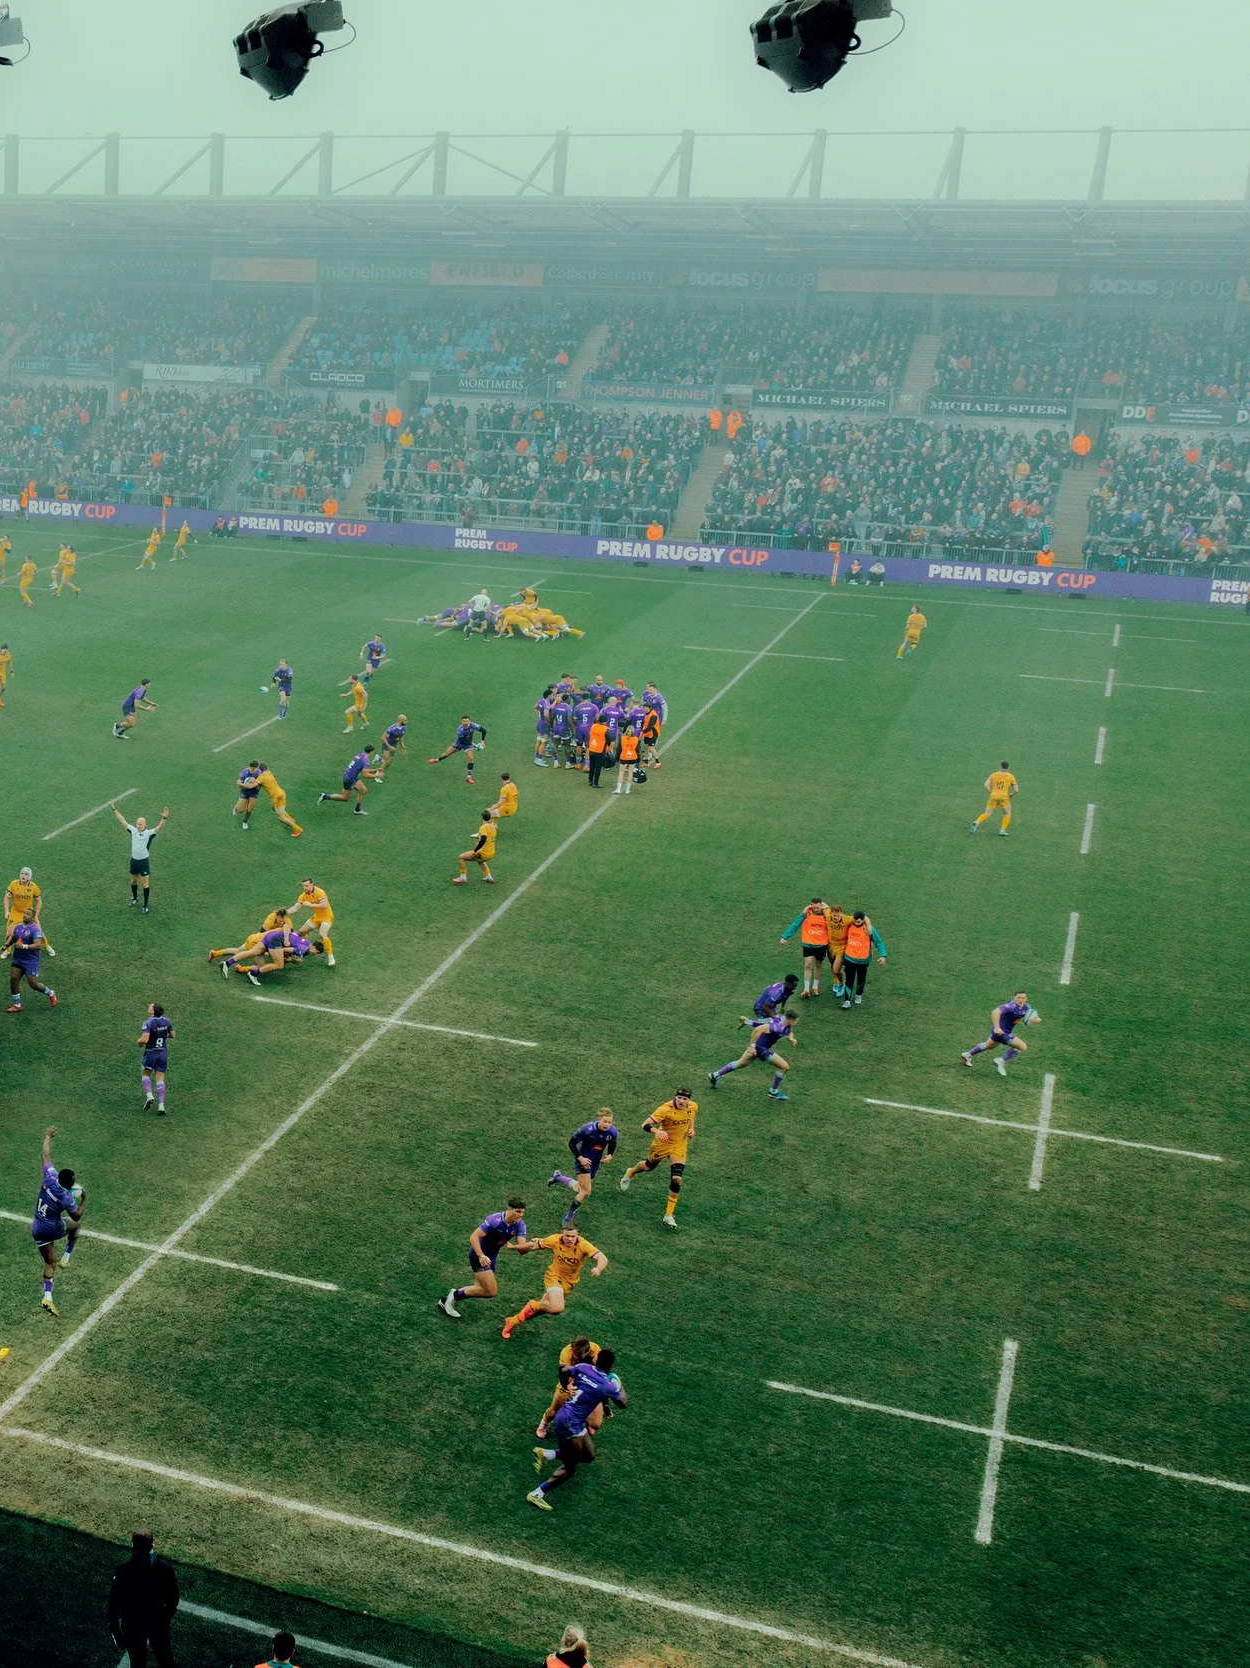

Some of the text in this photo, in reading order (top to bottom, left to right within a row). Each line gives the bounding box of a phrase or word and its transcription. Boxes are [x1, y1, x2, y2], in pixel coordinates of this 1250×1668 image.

[320, 259, 429, 281] michelmores
[446, 264, 524, 278] ENFIELD
[309, 372, 366, 383] CLADCO
[458, 377, 525, 390] MORTIMERS
[657, 389, 711, 401] JENNER
[756, 392, 887, 407] MICHAEL SPIERS
[928, 401, 1068, 416] MICHAEL SPIERS
[29, 500, 83, 518] RUGBY
[84, 503, 116, 520] CUP
[238, 515, 368, 538] PREM RUGBY CUP
[455, 527, 488, 540] PREM
[454, 538, 519, 553] RUGBY CUP
[596, 540, 769, 567] PREM RUGBY CUP
[928, 563, 1097, 590] PREM RUGBY CUP
[609, 717, 615, 728] 2
[37, 1198, 48, 1218] 14
[557, 1255, 579, 1264] cinch
